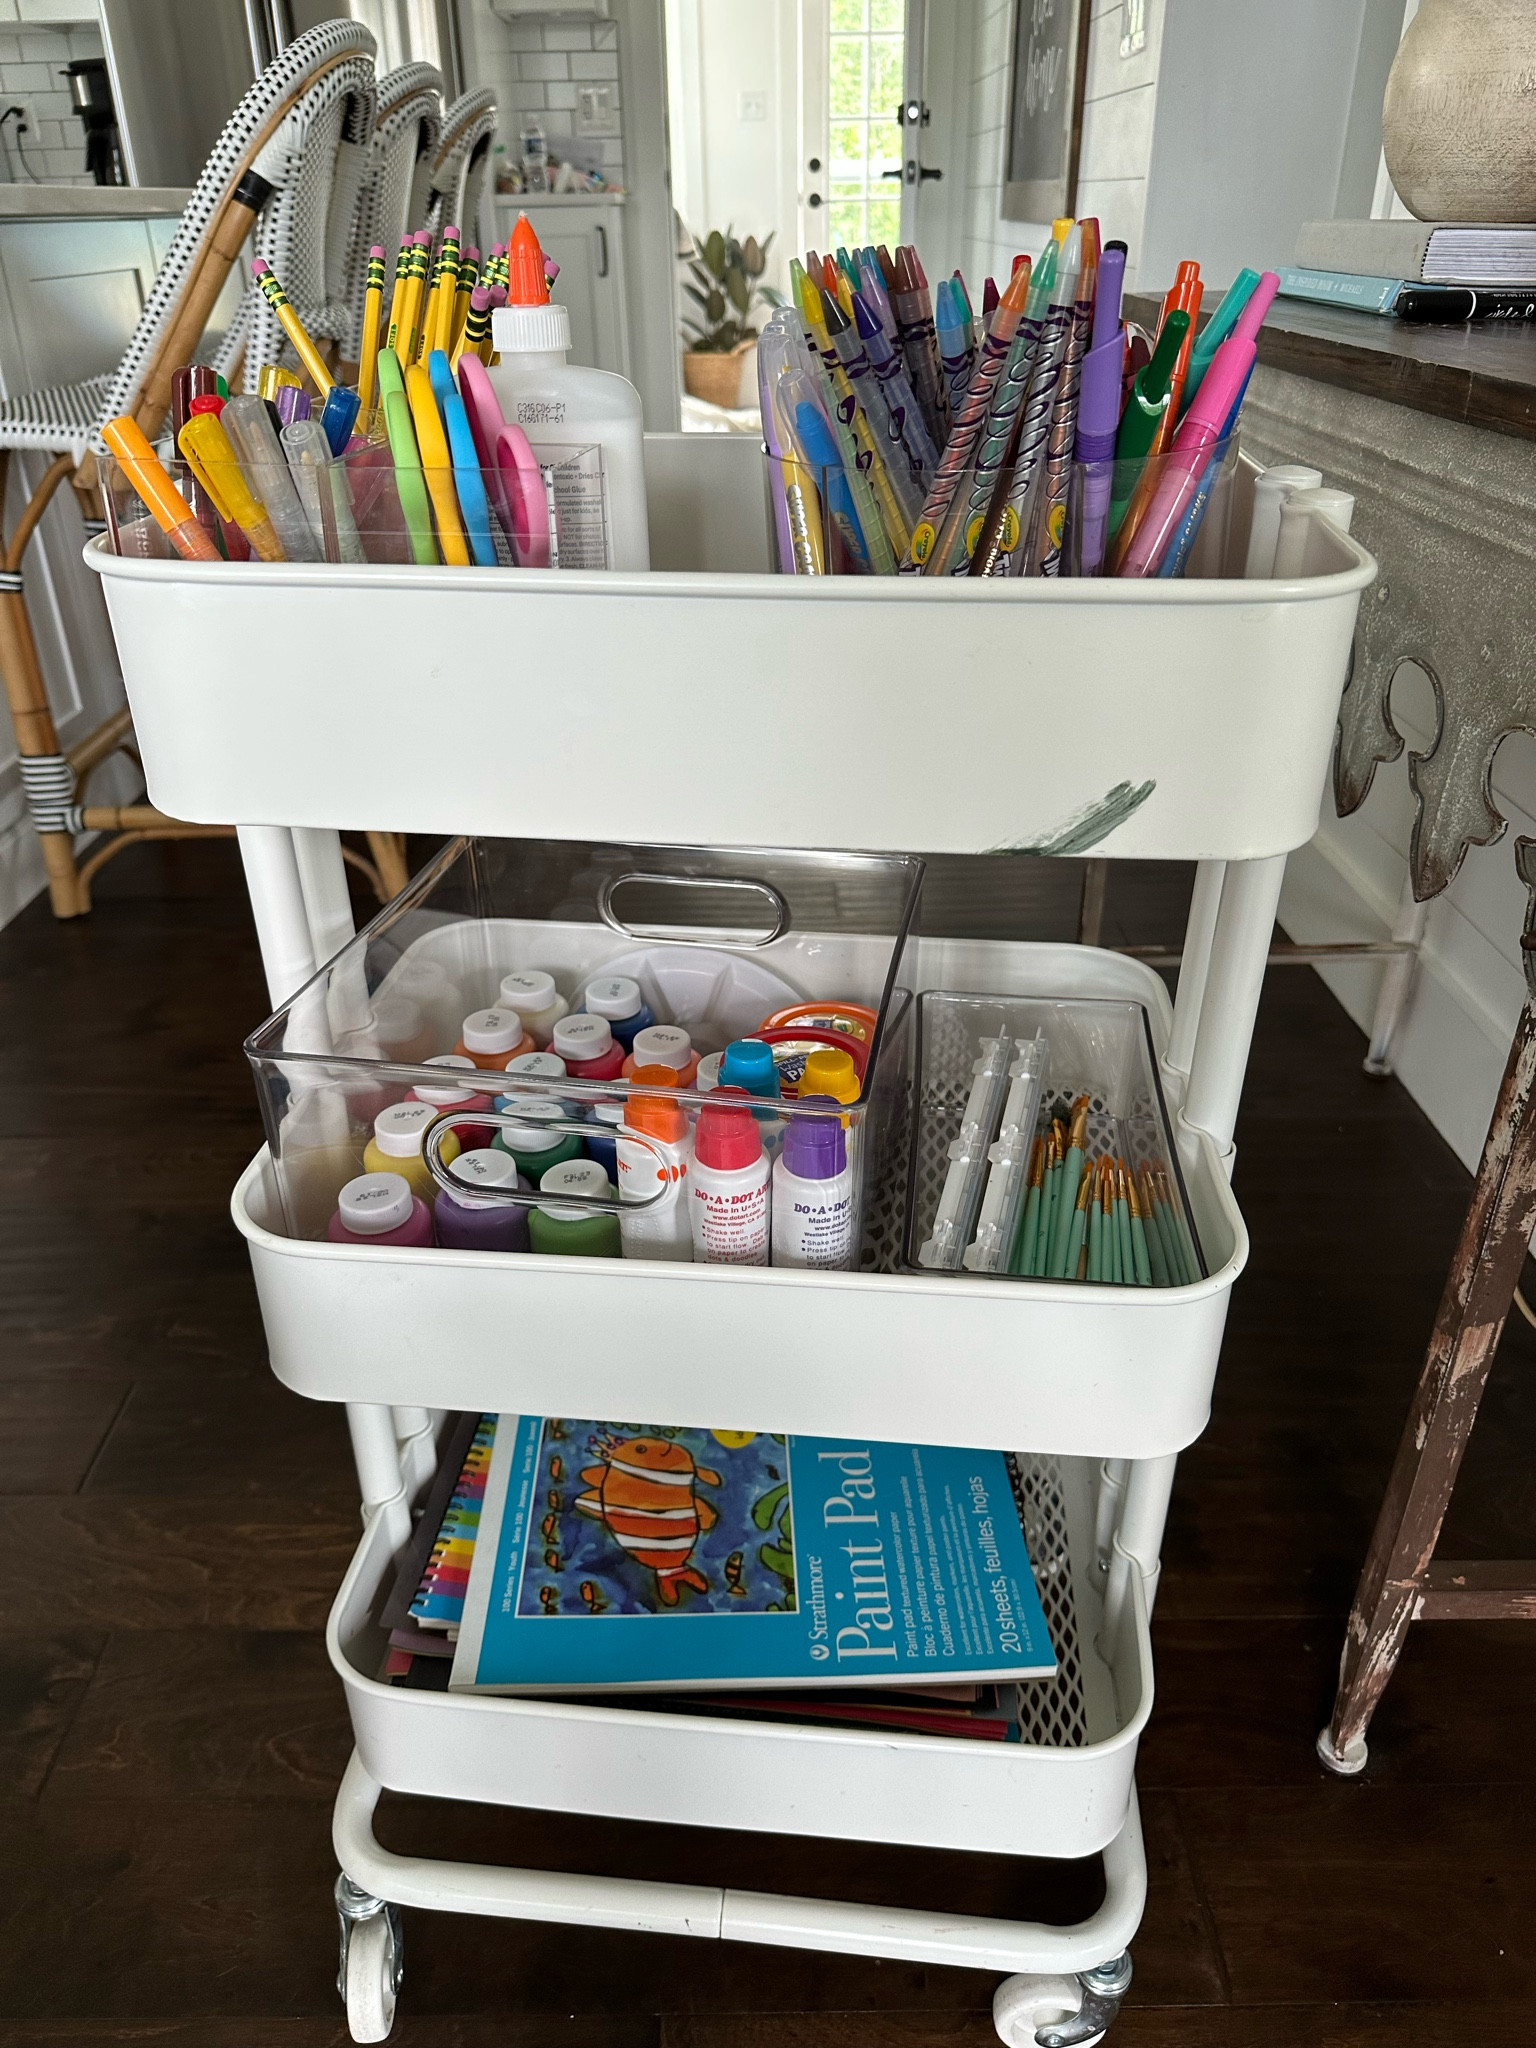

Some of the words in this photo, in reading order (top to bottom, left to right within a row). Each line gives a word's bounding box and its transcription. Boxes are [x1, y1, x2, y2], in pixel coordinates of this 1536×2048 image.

[554, 485, 570, 493] chool
[1005, 514, 1015, 546] Crayola
[921, 530, 931, 559] Crayola
[706, 1205, 729, 1213] Made
[706, 1227, 728, 1235] Shake
[706, 1234, 726, 1242] Press
[817, 1449, 879, 1528] Pad
[900, 1476, 912, 1508] aquarelle
[917, 1478, 927, 1493] para
[968, 1476, 989, 1513] hojas
[890, 1512, 900, 1532] paper
[906, 1510, 916, 1526] pour
[920, 1495, 932, 1533] texturizado
[893, 1534, 905, 1573] watercolor
[926, 1535, 937, 1555] papel
[978, 1517, 1002, 1573] feuilles,
[508, 1551, 517, 1571] Youth
[913, 1556, 924, 1578] papier
[929, 1557, 944, 1590] pintura
[504, 1576, 514, 1597] Series
[806, 1557, 828, 1639] Strathmore
[898, 1575, 910, 1606] textured
[502, 1598, 511, 1612] 100
[835, 1538, 898, 1662] Paint
[916, 1581, 933, 1622] peinture
[934, 1593, 945, 1605] de
[990, 1576, 1016, 1629] sheets,
[901, 1609, 916, 1628] pad
[905, 1631, 918, 1657] Paint
[938, 1608, 955, 1656] Cuaderno
[999, 1632, 1022, 1653] 20
[924, 1634, 937, 1656] Bloc
